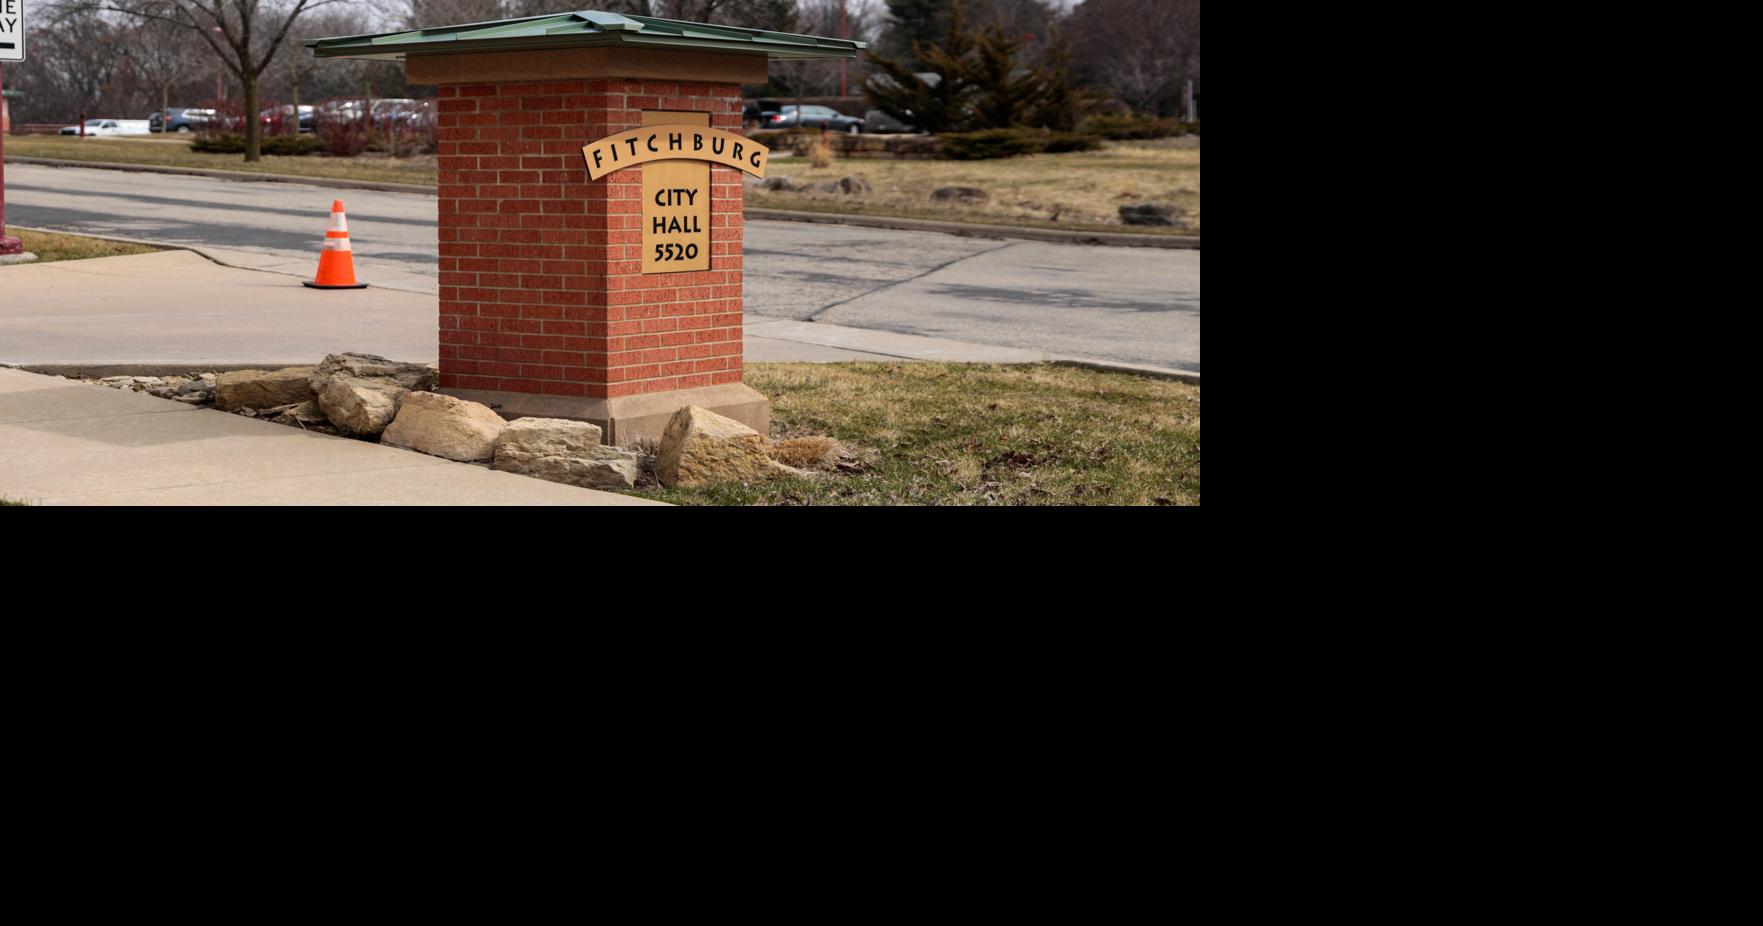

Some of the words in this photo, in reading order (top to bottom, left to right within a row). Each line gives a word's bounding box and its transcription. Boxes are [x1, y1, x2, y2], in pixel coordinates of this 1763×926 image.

[593, 132, 761, 169] FITCHBURG
[655, 188, 698, 206] CITY
[652, 215, 701, 234] HALL
[654, 243, 698, 262] 5520
